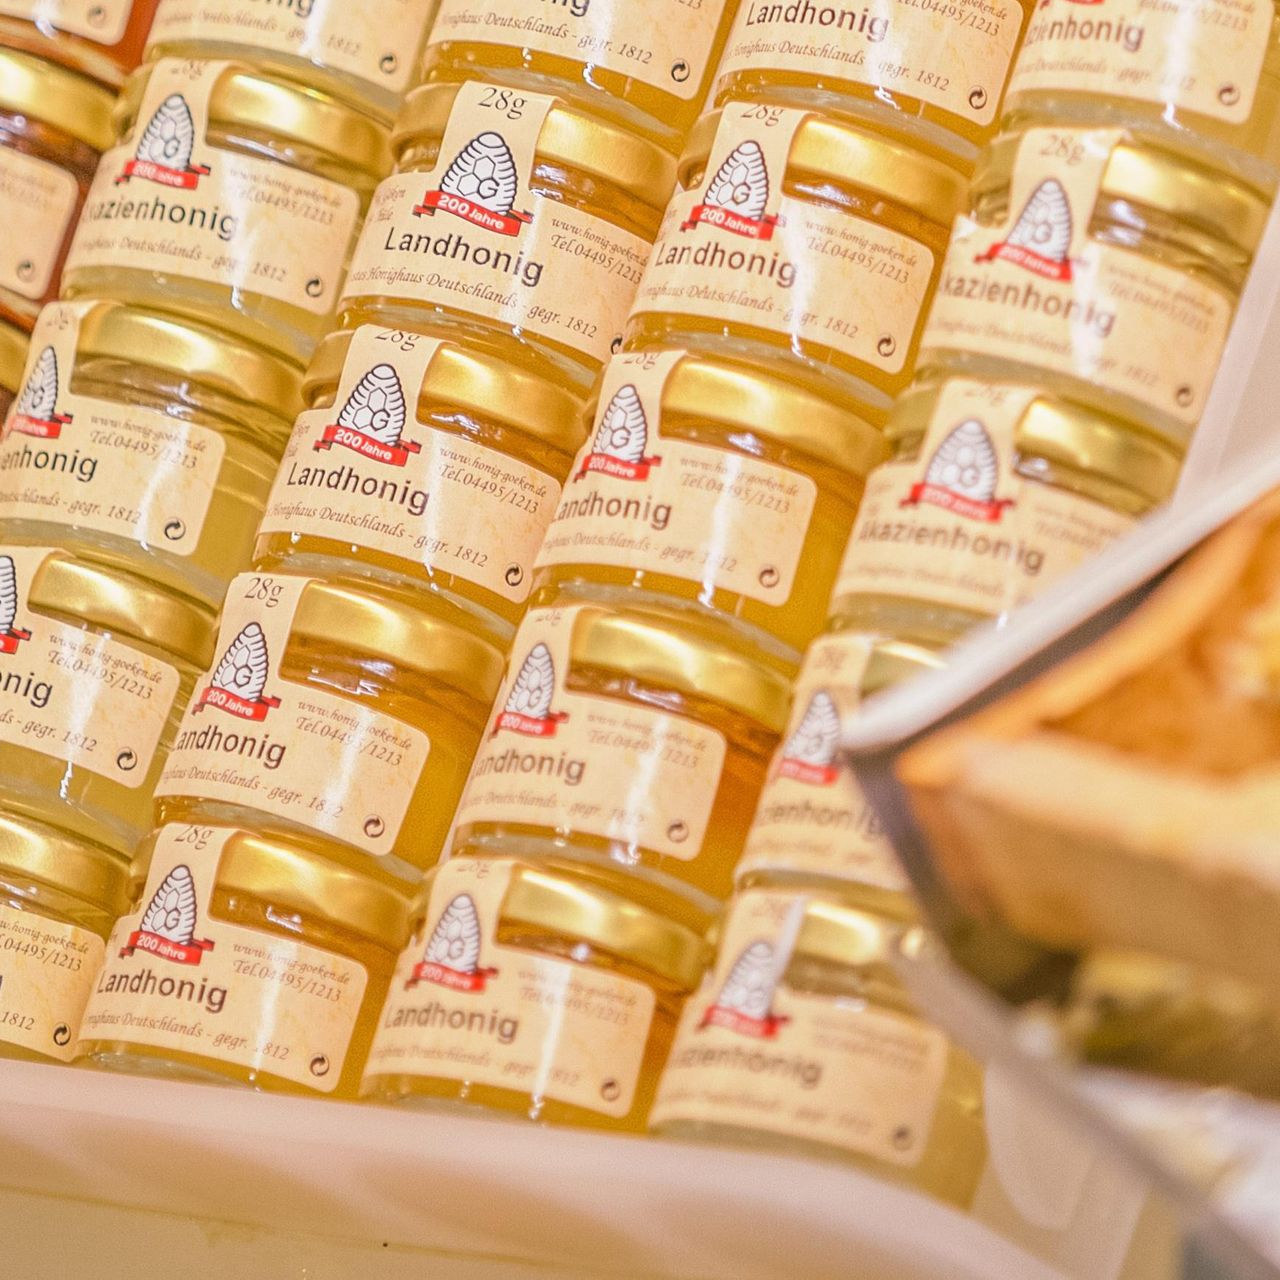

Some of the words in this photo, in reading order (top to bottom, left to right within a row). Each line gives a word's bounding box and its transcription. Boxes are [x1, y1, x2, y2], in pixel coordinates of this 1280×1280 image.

[484, 11, 568, 39] Deutschlands
[617, 40, 652, 64] 1812
[747, 0, 889, 43] Landhonig
[778, 40, 865, 66] Deutschlands
[916, 70, 950, 92] 1812
[478, 87, 528, 120] 28g
[437, 195, 468, 216] 200
[466, 206, 504, 230] Jahre
[700, 206, 724, 225] 200
[722, 217, 758, 236] Jahre
[384, 227, 544, 287] Landhonig
[655, 241, 798, 288] Landhonig
[808, 237, 910, 285] Tel.04495/1213
[426, 274, 518, 309] Deutschlands
[527, 305, 561, 325] gegr.
[566, 315, 598, 338] 1812
[825, 316, 859, 339] 1812
[334, 428, 362, 446] 200
[359, 439, 392, 461] Jahre
[287, 461, 430, 516] Landhonig
[440, 446, 547, 498] www.honig-goeken.de
[439, 465, 540, 515] Tel.04495/1213
[319, 505, 406, 538] Deutschlands
[455, 545, 488, 568] 1812
[244, 577, 284, 608] 28g
[206, 689, 227, 706] 200
[224, 699, 254, 717] Jahre
[21, 721, 57, 740] gegr.
[266, 782, 302, 805] gegr.
[174, 825, 214, 850] 28g
[136, 934, 158, 951] 200
[155, 944, 186, 961] Jahre
[97, 969, 228, 1013] Landhonig
[1, 1012, 35, 1031] 1812
[212, 1030, 249, 1050] gegr.
